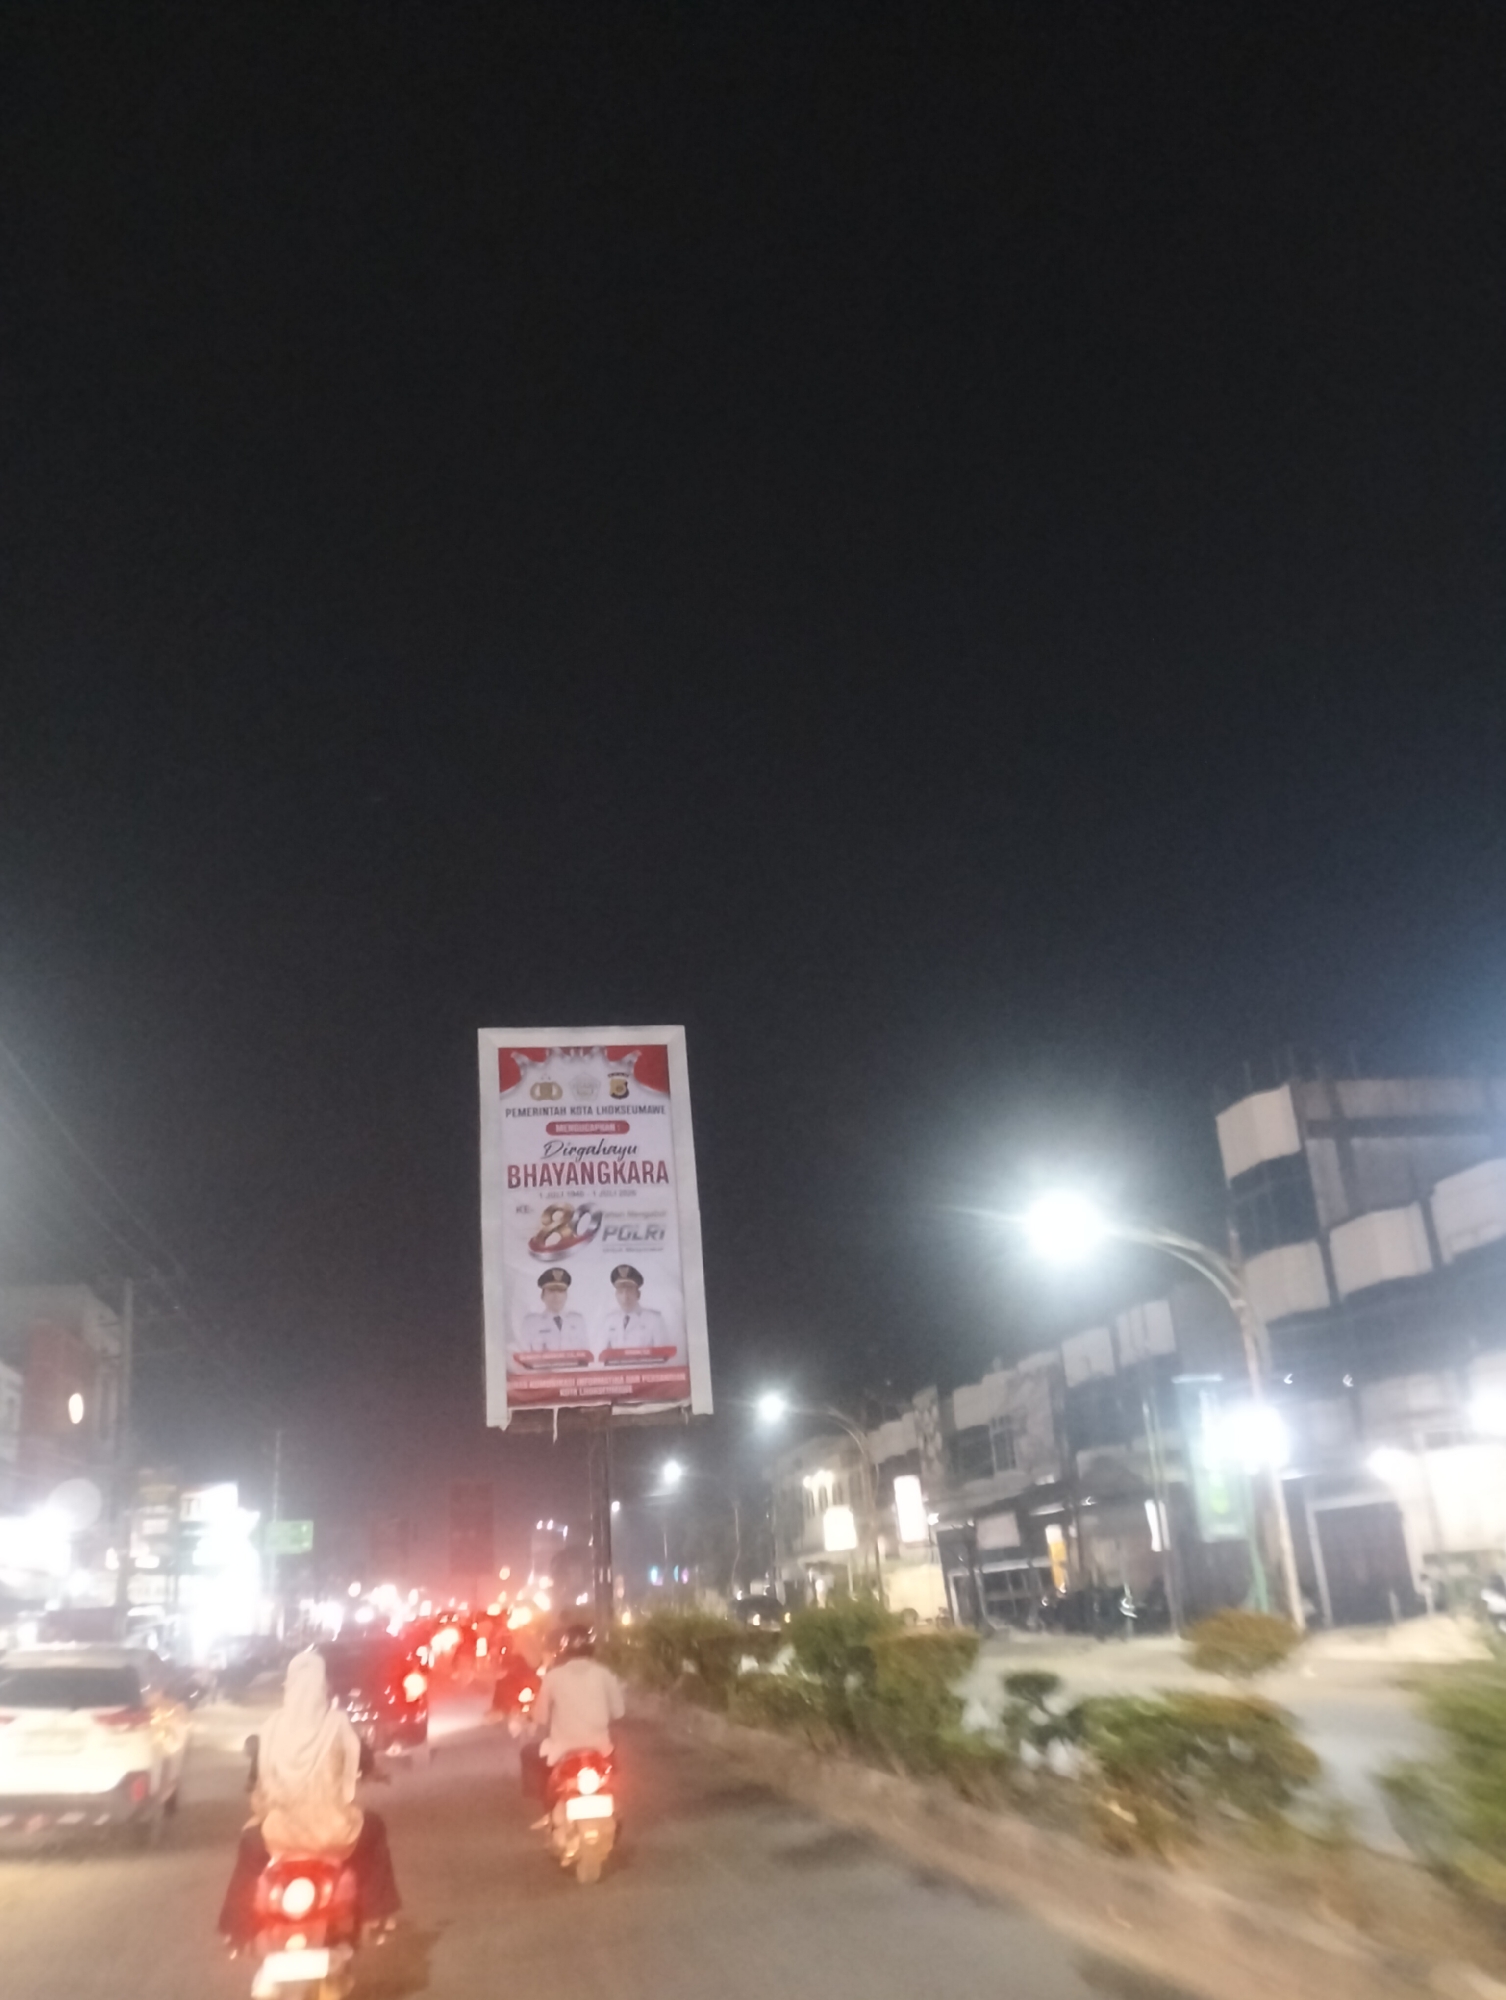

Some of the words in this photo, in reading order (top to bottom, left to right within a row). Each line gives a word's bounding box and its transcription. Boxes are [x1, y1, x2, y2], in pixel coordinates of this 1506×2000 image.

[505, 1107, 566, 1118] PEMERINTAH
[570, 1106, 593, 1116] KOTA
[596, 1104, 666, 1115] LHOKSEUMAWE
[540, 1138, 638, 1162] Dirgahayu
[507, 1160, 670, 1190] BHAYANGKARA
